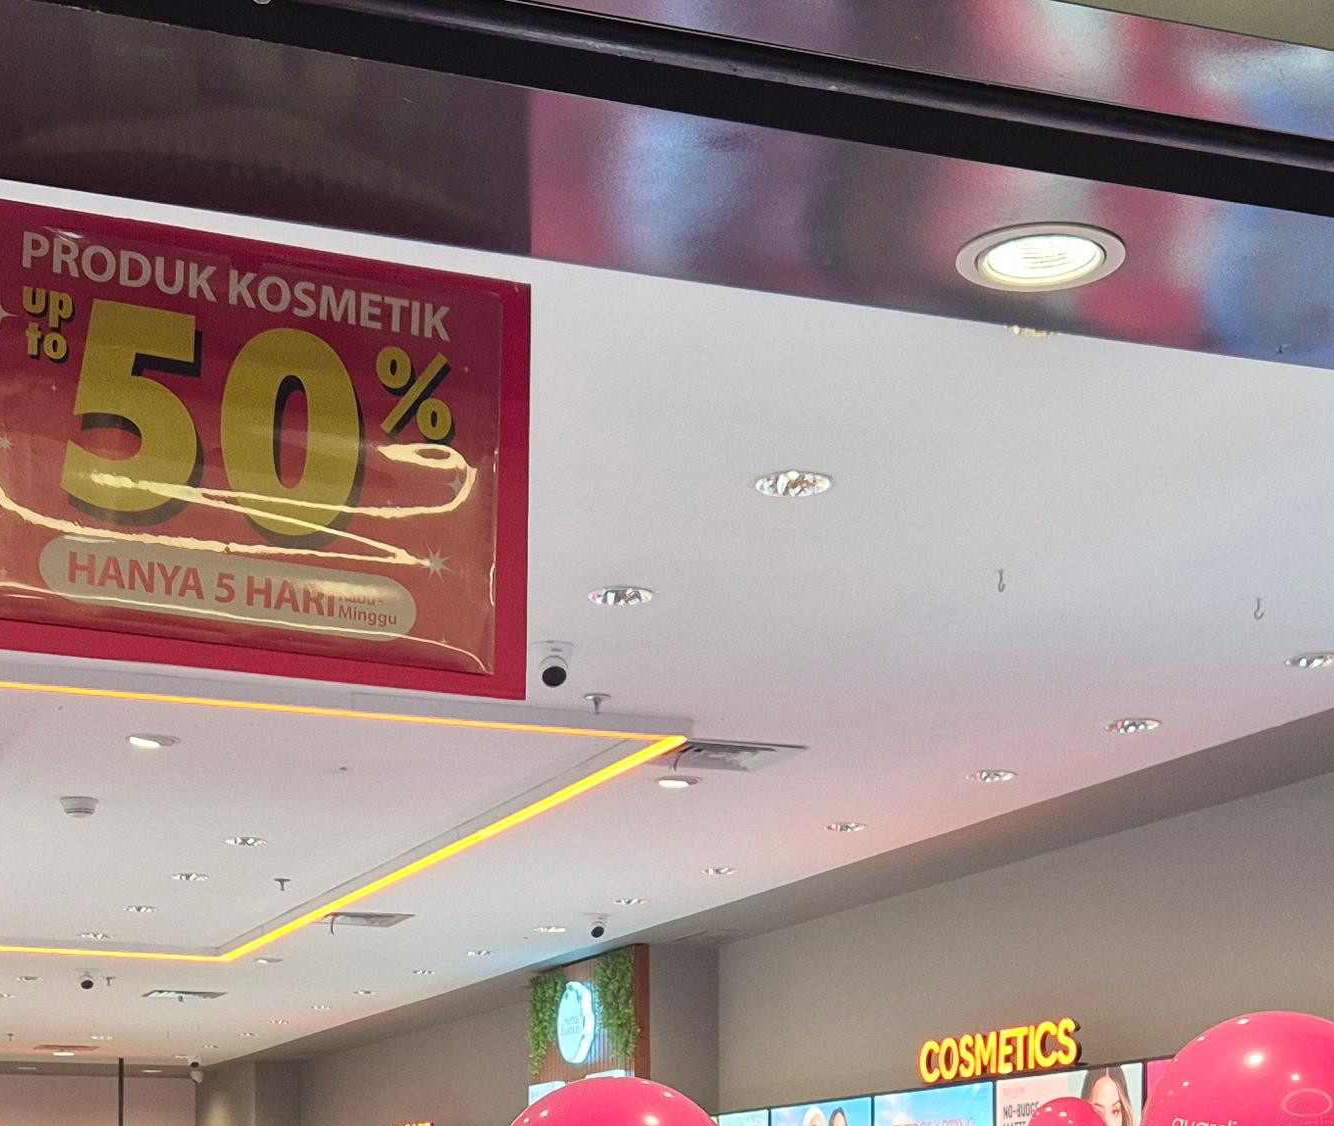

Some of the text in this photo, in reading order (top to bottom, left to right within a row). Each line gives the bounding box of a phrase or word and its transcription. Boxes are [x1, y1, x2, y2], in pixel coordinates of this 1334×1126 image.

[22, 231, 451, 342] PRODUK KOSMETIK
[22, 286, 73, 328] up
[25, 322, 68, 361] to
[68, 551, 335, 618] HANYA 5 HARI
[338, 604, 398, 627] Minggu
[918, 1018, 1079, 1083] COSMETICS
